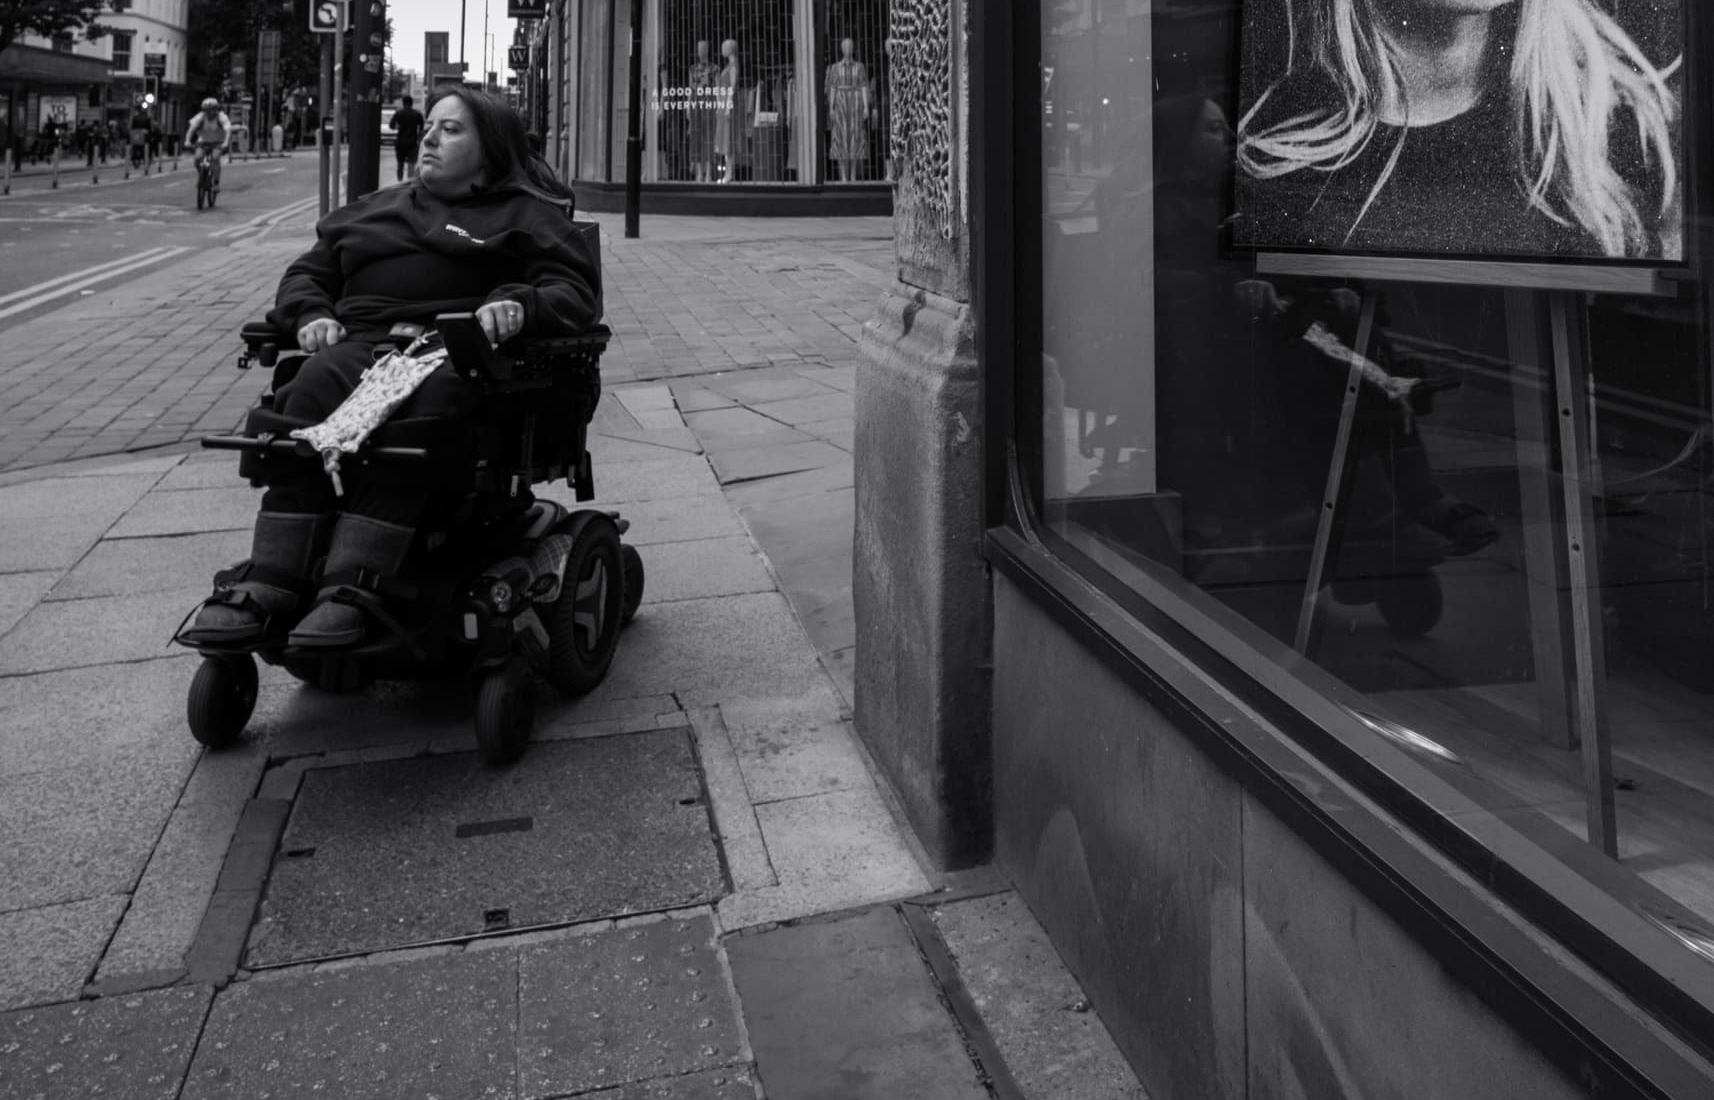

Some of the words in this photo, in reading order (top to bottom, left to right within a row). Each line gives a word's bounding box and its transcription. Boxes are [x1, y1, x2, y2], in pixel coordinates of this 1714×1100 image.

[511, 50, 527, 62] W
[652, 87, 658, 97] A
[662, 87, 692, 97] GOOD
[696, 86, 734, 97] DRESS
[651, 102, 659, 111] IS
[663, 100, 734, 111] EVERYTHING
